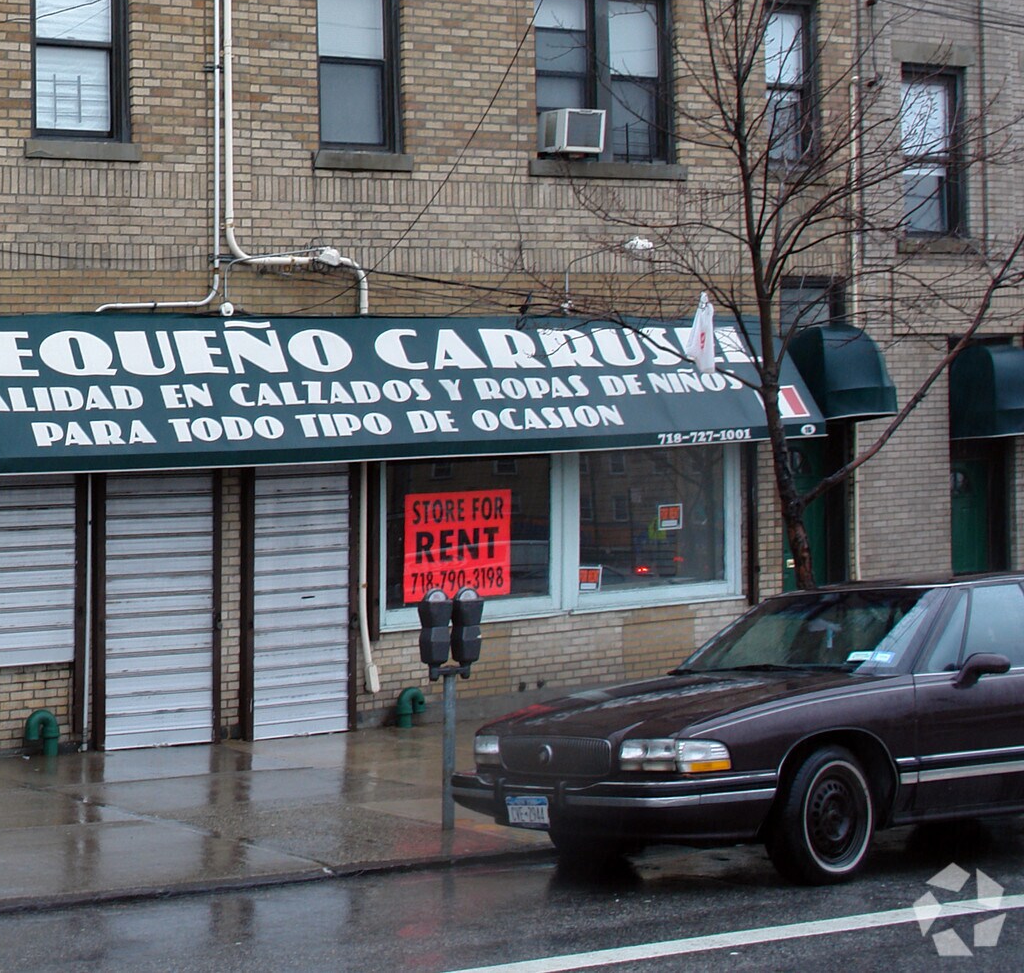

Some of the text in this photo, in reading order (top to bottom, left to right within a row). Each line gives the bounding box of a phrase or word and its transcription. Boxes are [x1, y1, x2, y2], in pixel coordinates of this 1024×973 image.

[160, 383, 213, 408] EN
[230, 379, 430, 406] CALZADOS
[440, 379, 462, 400] Y
[474, 375, 589, 399] ROPAS
[601, 374, 646, 396] DE
[647, 369, 743, 393] NIÑOS
[32, 405, 624, 446] PARA TODO TIPO DE OCASION
[659, 429, 750, 446] 718-727-1001
[412, 496, 504, 525] STORE FOR
[415, 526, 499, 564] RENT
[411, 566, 504, 594] 718-790-3198
